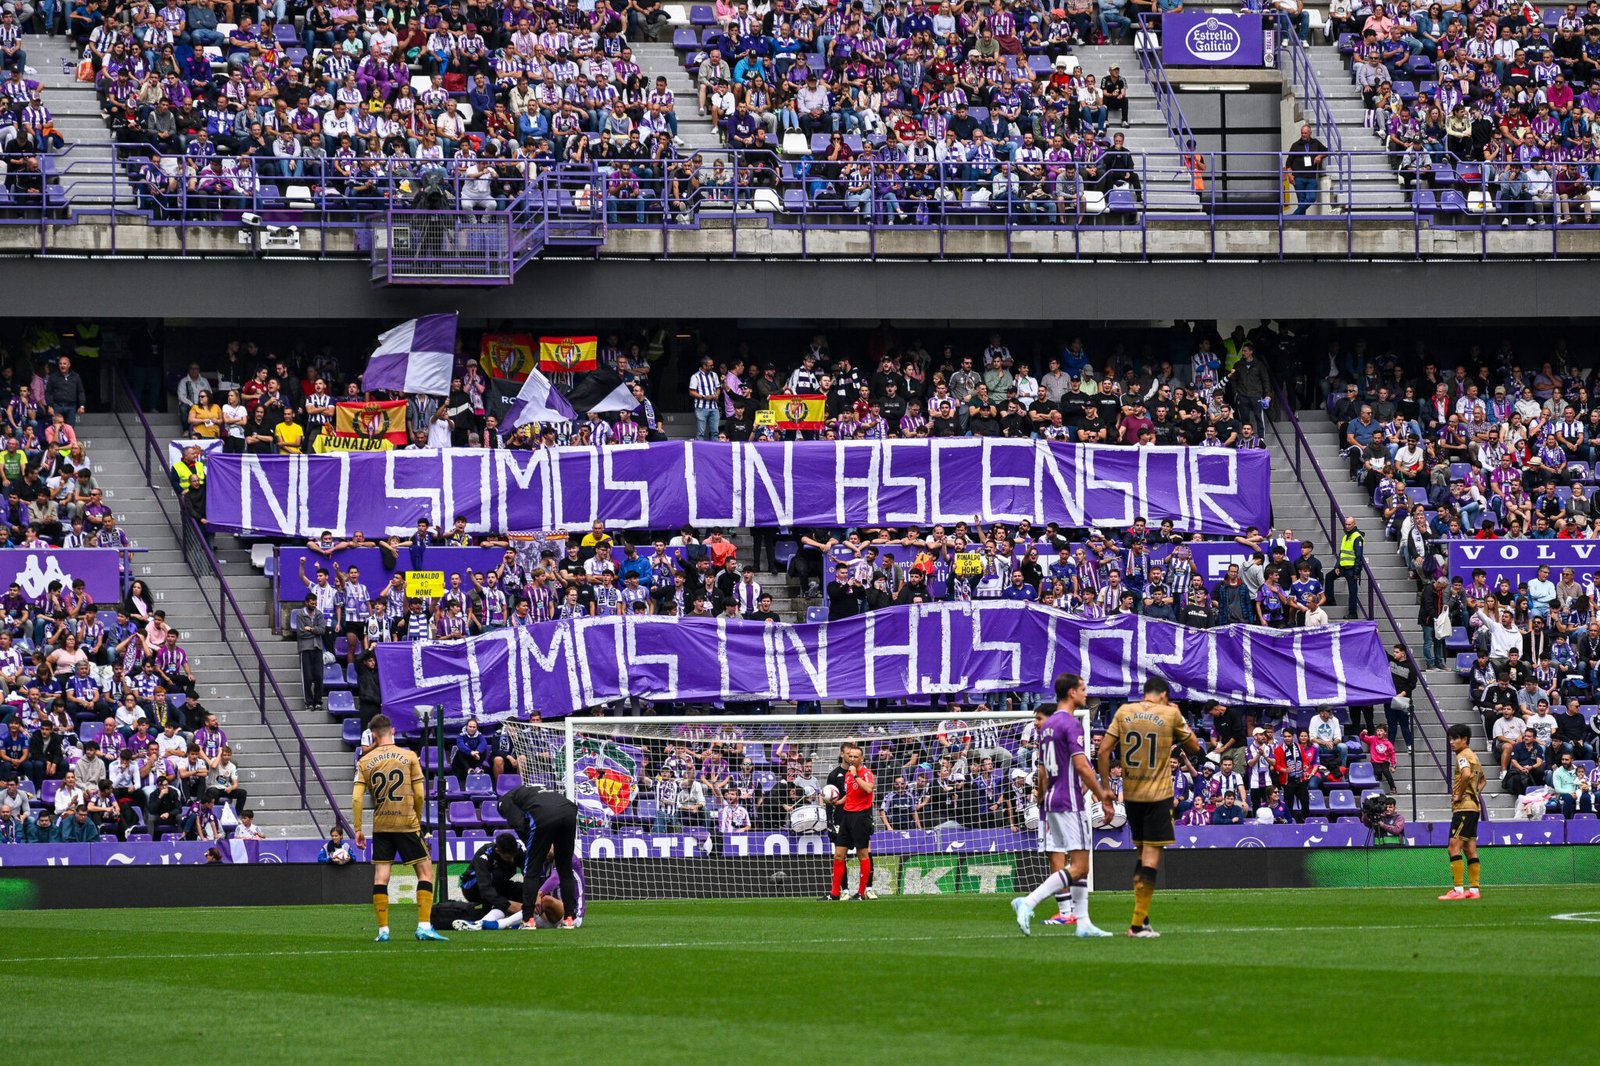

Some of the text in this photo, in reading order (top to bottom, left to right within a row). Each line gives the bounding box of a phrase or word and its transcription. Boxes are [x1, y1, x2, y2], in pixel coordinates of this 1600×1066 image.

[1193, 30, 1233, 40] Estrella
[1195, 40, 1232, 52] Galicia
[240, 437, 1240, 538] NO SOMOS UN ASCENSOR
[412, 614, 679, 726] SOMOS
[716, 617, 828, 700] UN
[366, 752, 409, 770] TURRIENTES
[1041, 741, 1058, 776] 14
[1125, 730, 1158, 769] 21
[371, 768, 404, 804] 22
